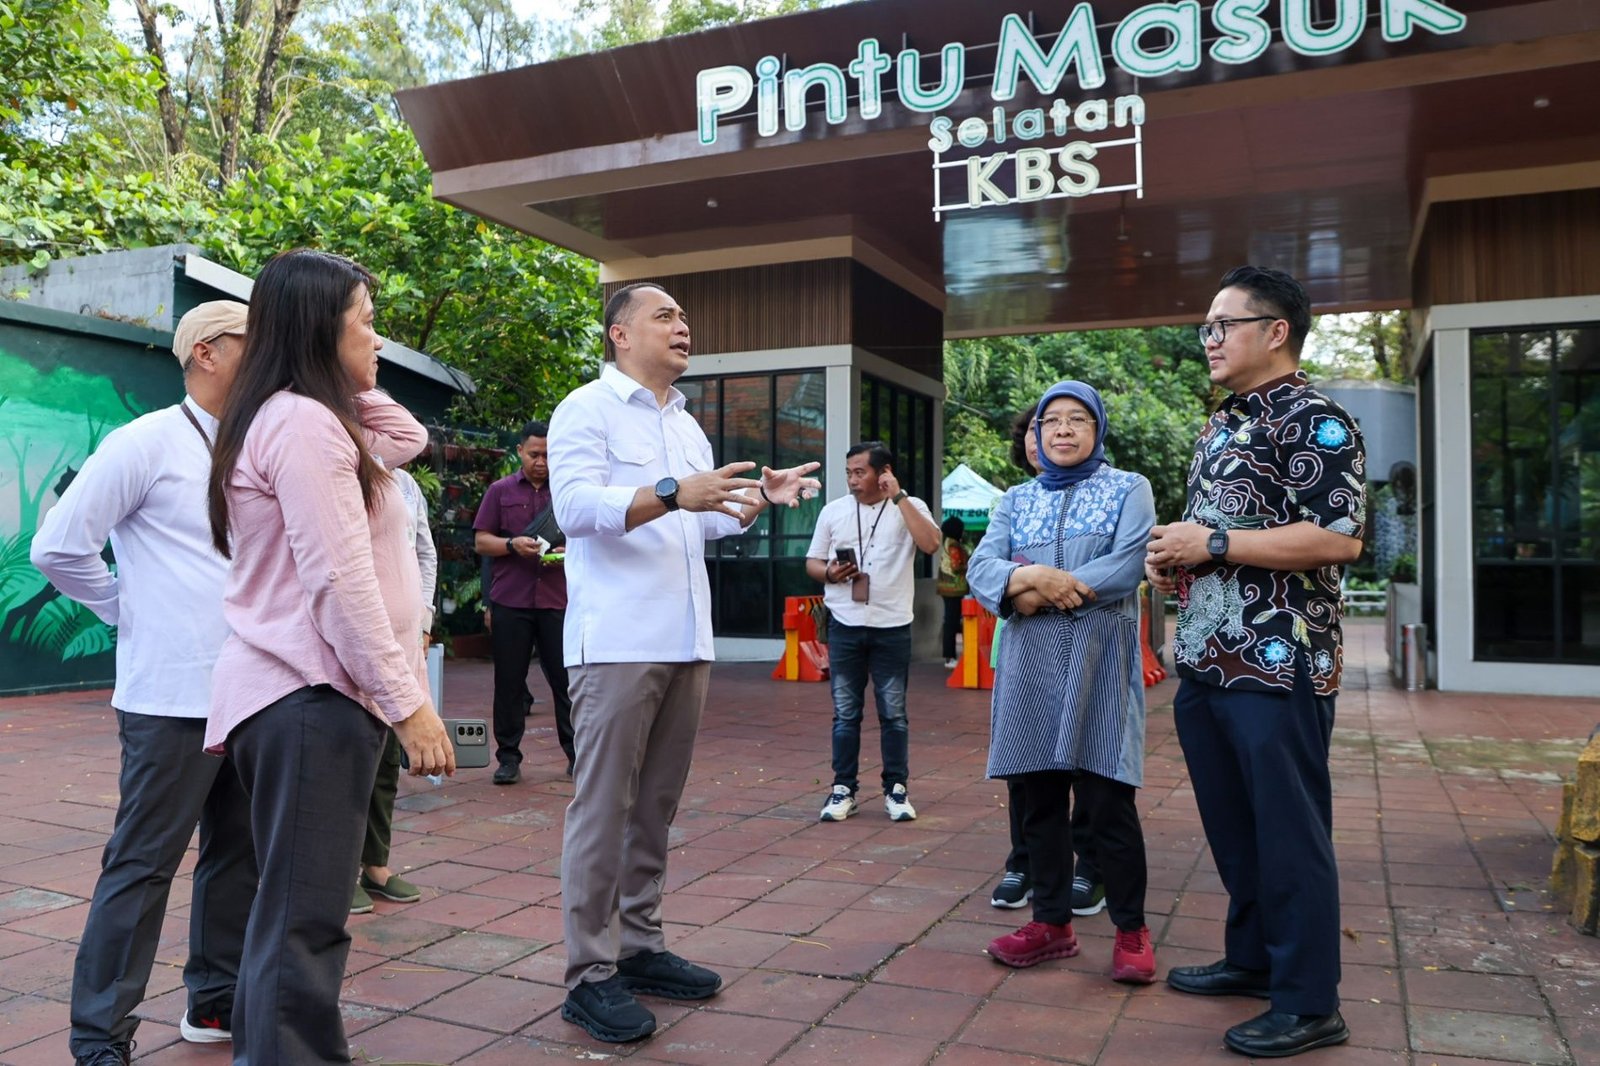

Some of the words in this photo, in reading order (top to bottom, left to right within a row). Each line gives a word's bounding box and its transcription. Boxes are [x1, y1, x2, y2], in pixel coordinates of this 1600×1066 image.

[696, 38, 965, 145] Pintu
[928, 95, 1145, 153] Selatan
[967, 140, 1100, 209] KBS
